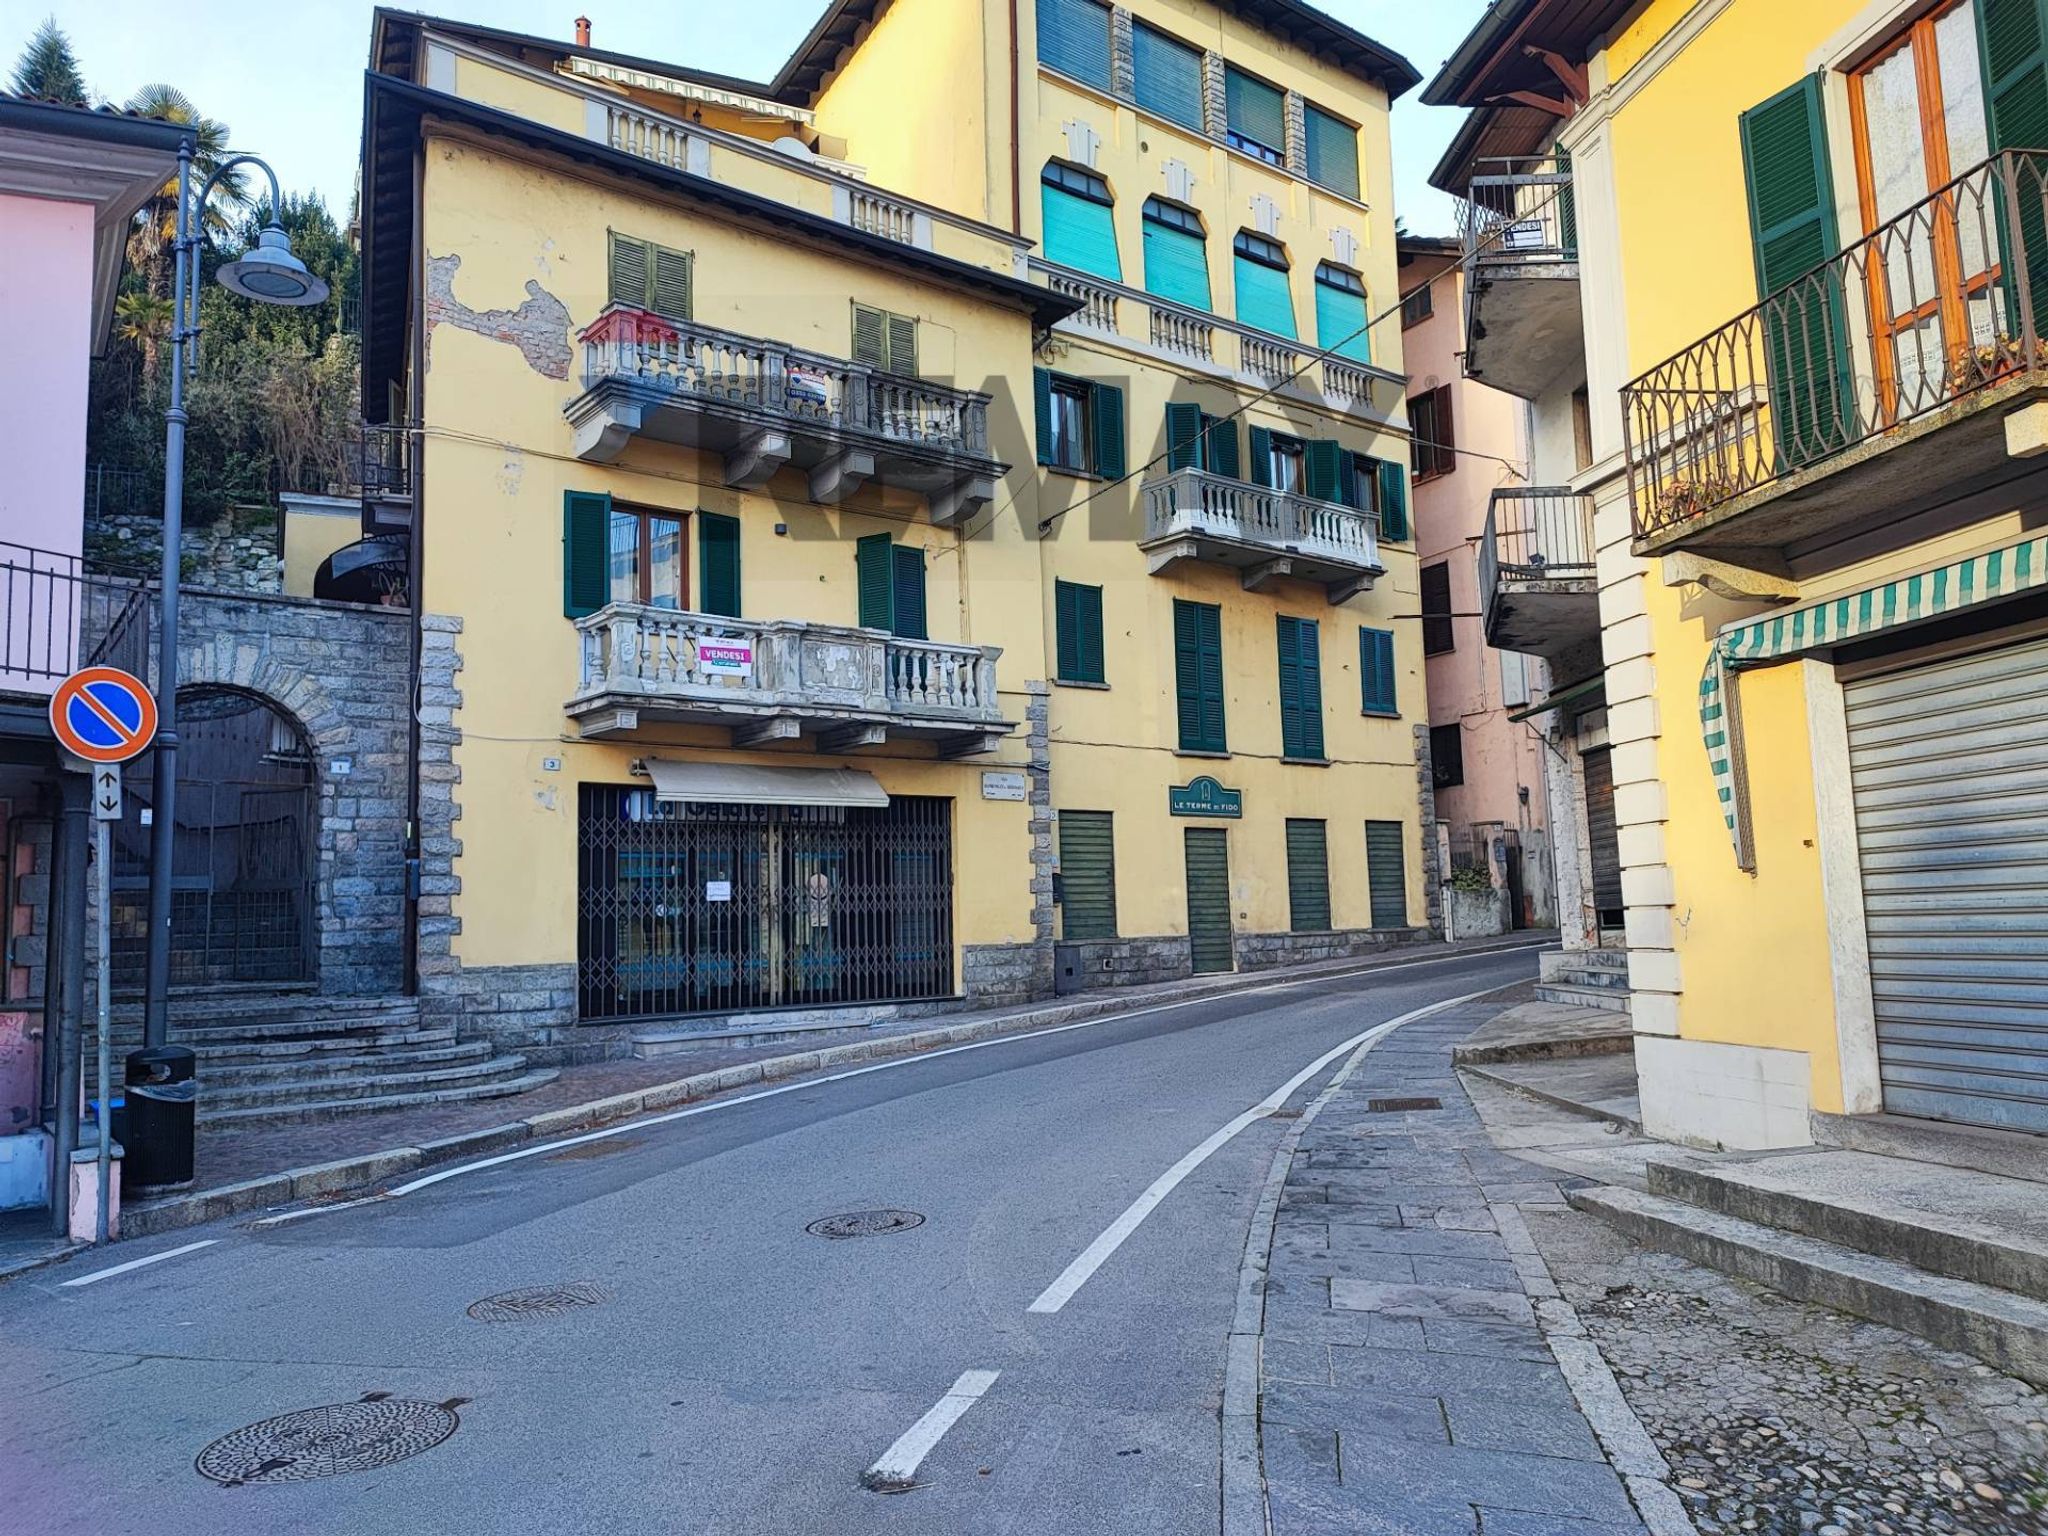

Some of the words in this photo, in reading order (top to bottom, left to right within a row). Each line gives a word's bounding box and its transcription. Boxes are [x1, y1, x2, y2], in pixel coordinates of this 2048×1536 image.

[704, 649, 745, 661] VENDESI
[648, 793, 674, 815] La
[1174, 801, 1184, 809] LE
[1186, 801, 1212, 811] TERME
[1221, 803, 1239, 812] FIDO
